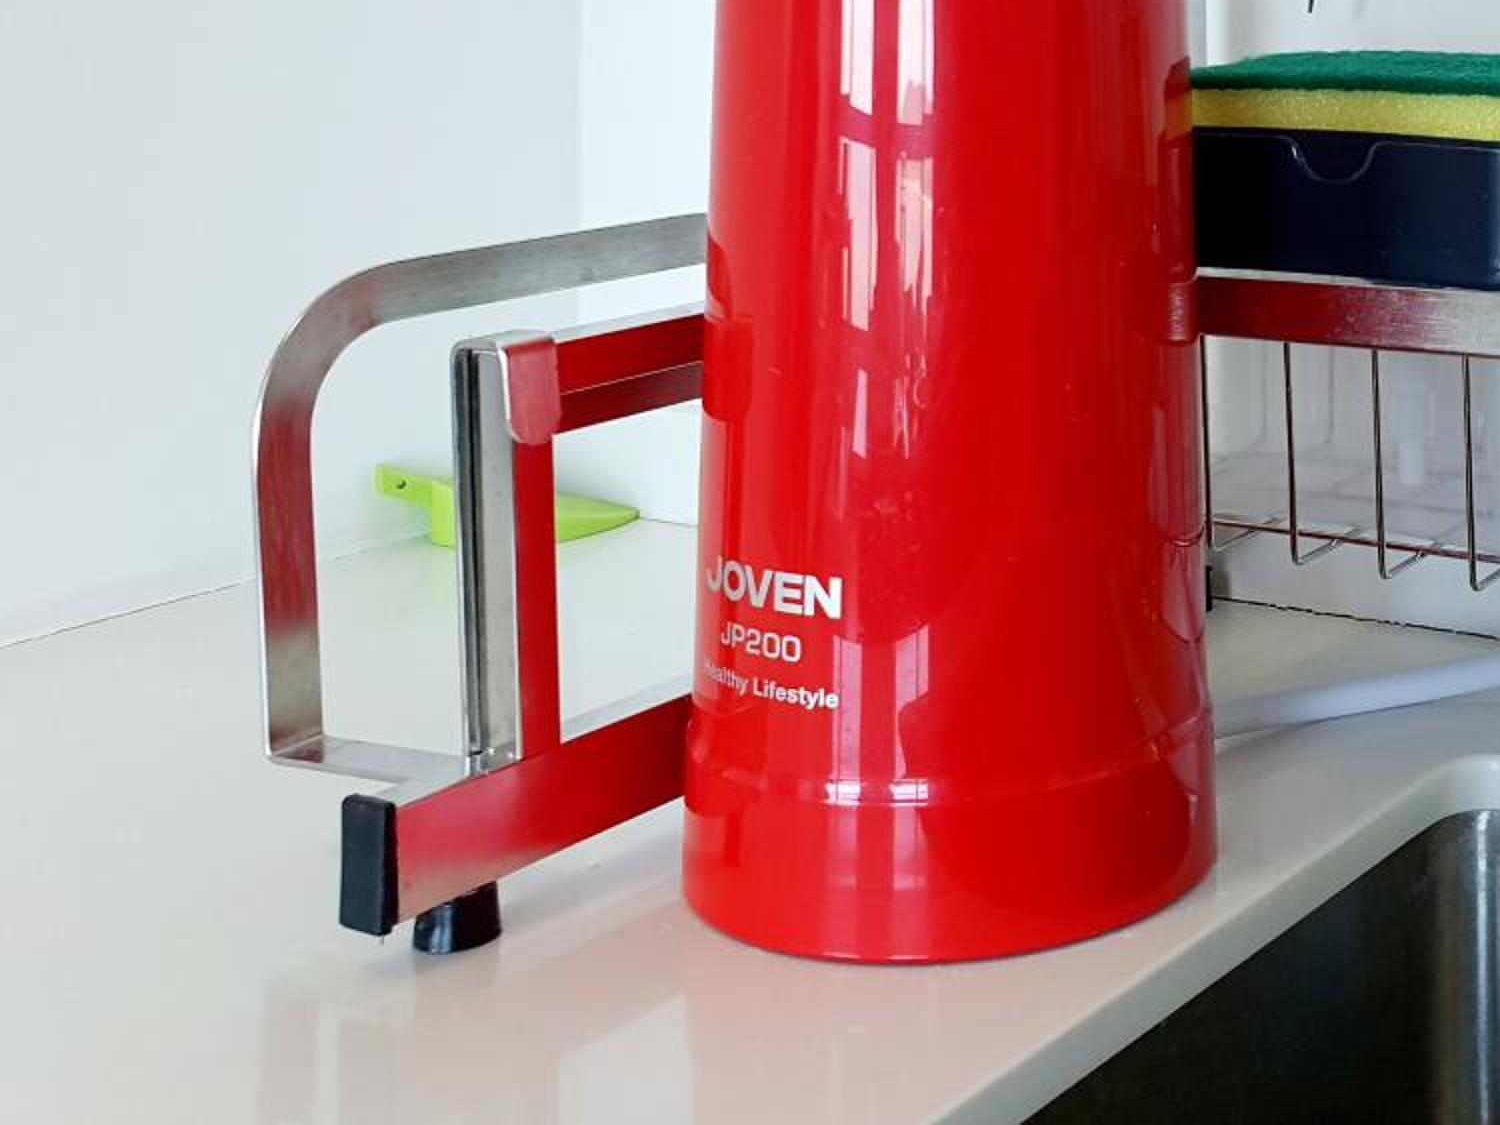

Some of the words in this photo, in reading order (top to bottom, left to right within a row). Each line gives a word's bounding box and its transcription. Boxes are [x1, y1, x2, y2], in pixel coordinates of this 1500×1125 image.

[706, 555, 843, 619] JOVEN
[721, 621, 801, 662] JP200
[752, 677, 839, 709] Lifestyle
